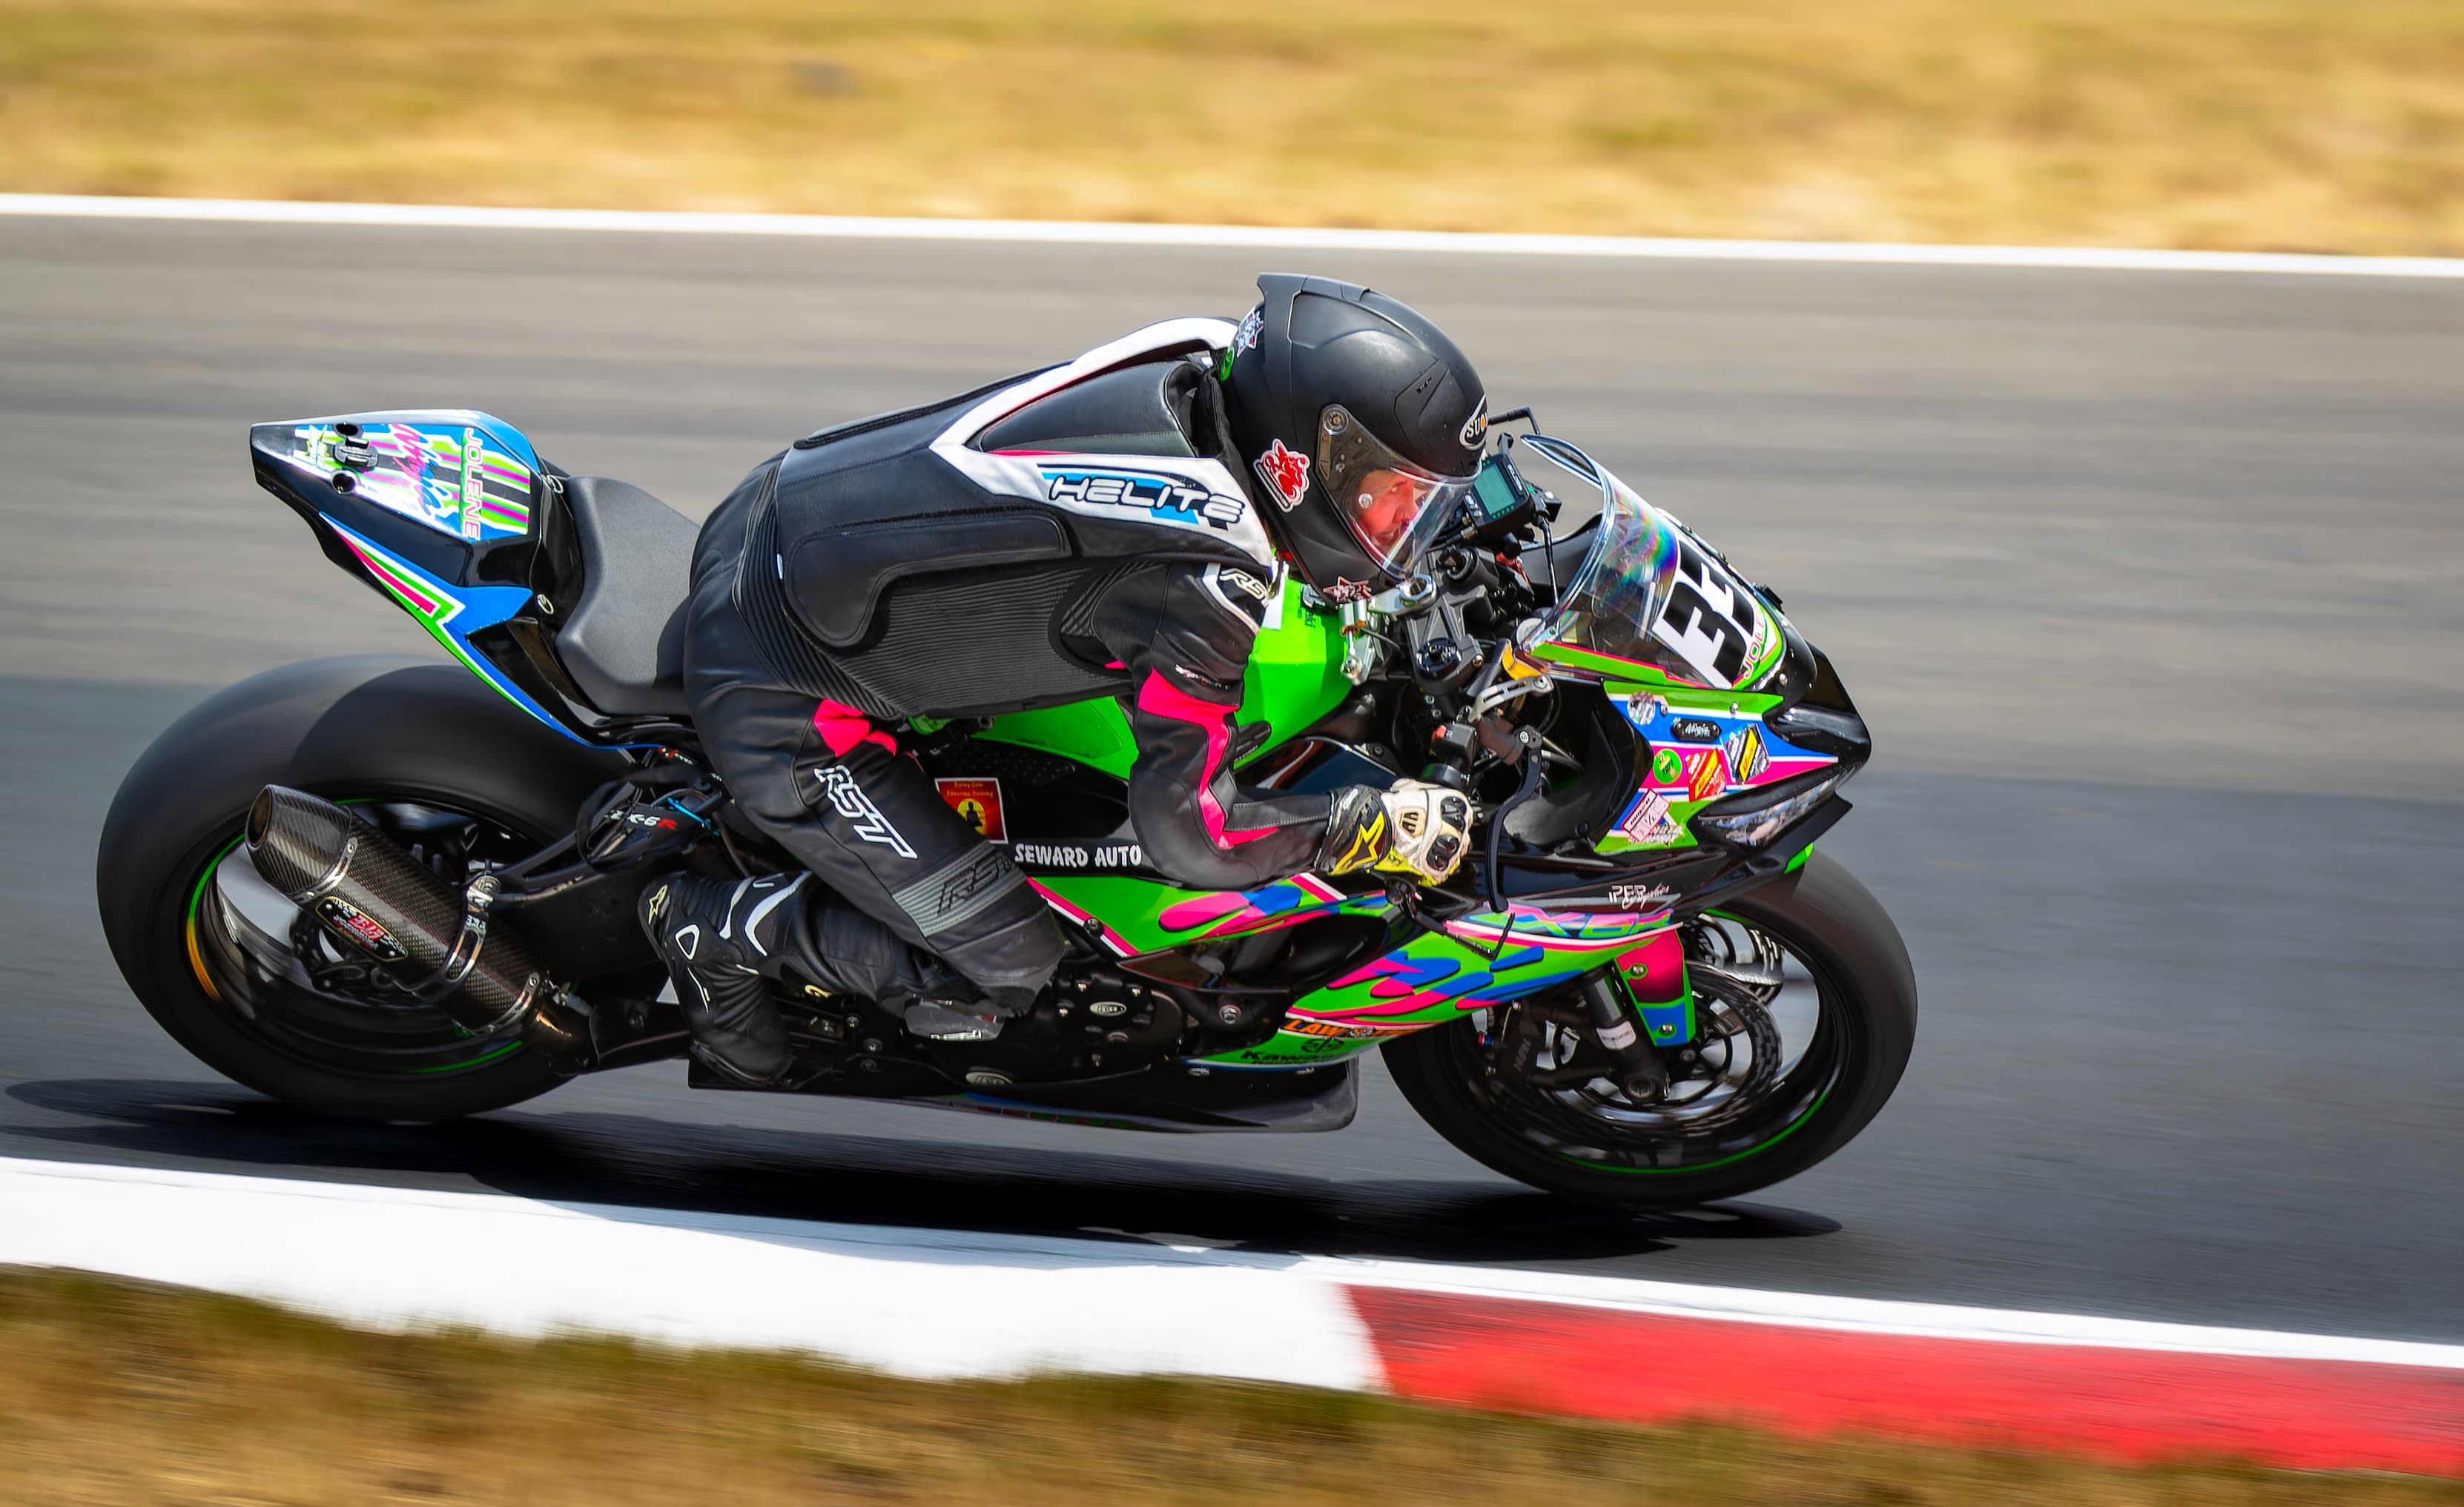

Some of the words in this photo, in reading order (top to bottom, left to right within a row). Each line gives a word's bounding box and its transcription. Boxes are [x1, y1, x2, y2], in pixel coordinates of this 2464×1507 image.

[463, 427, 483, 541] JOLENE
[1048, 475, 1245, 523] HELITE
[813, 764, 918, 859] RST
[1014, 843, 1089, 868] SEWARD
[1094, 844, 1143, 867] AUTO
